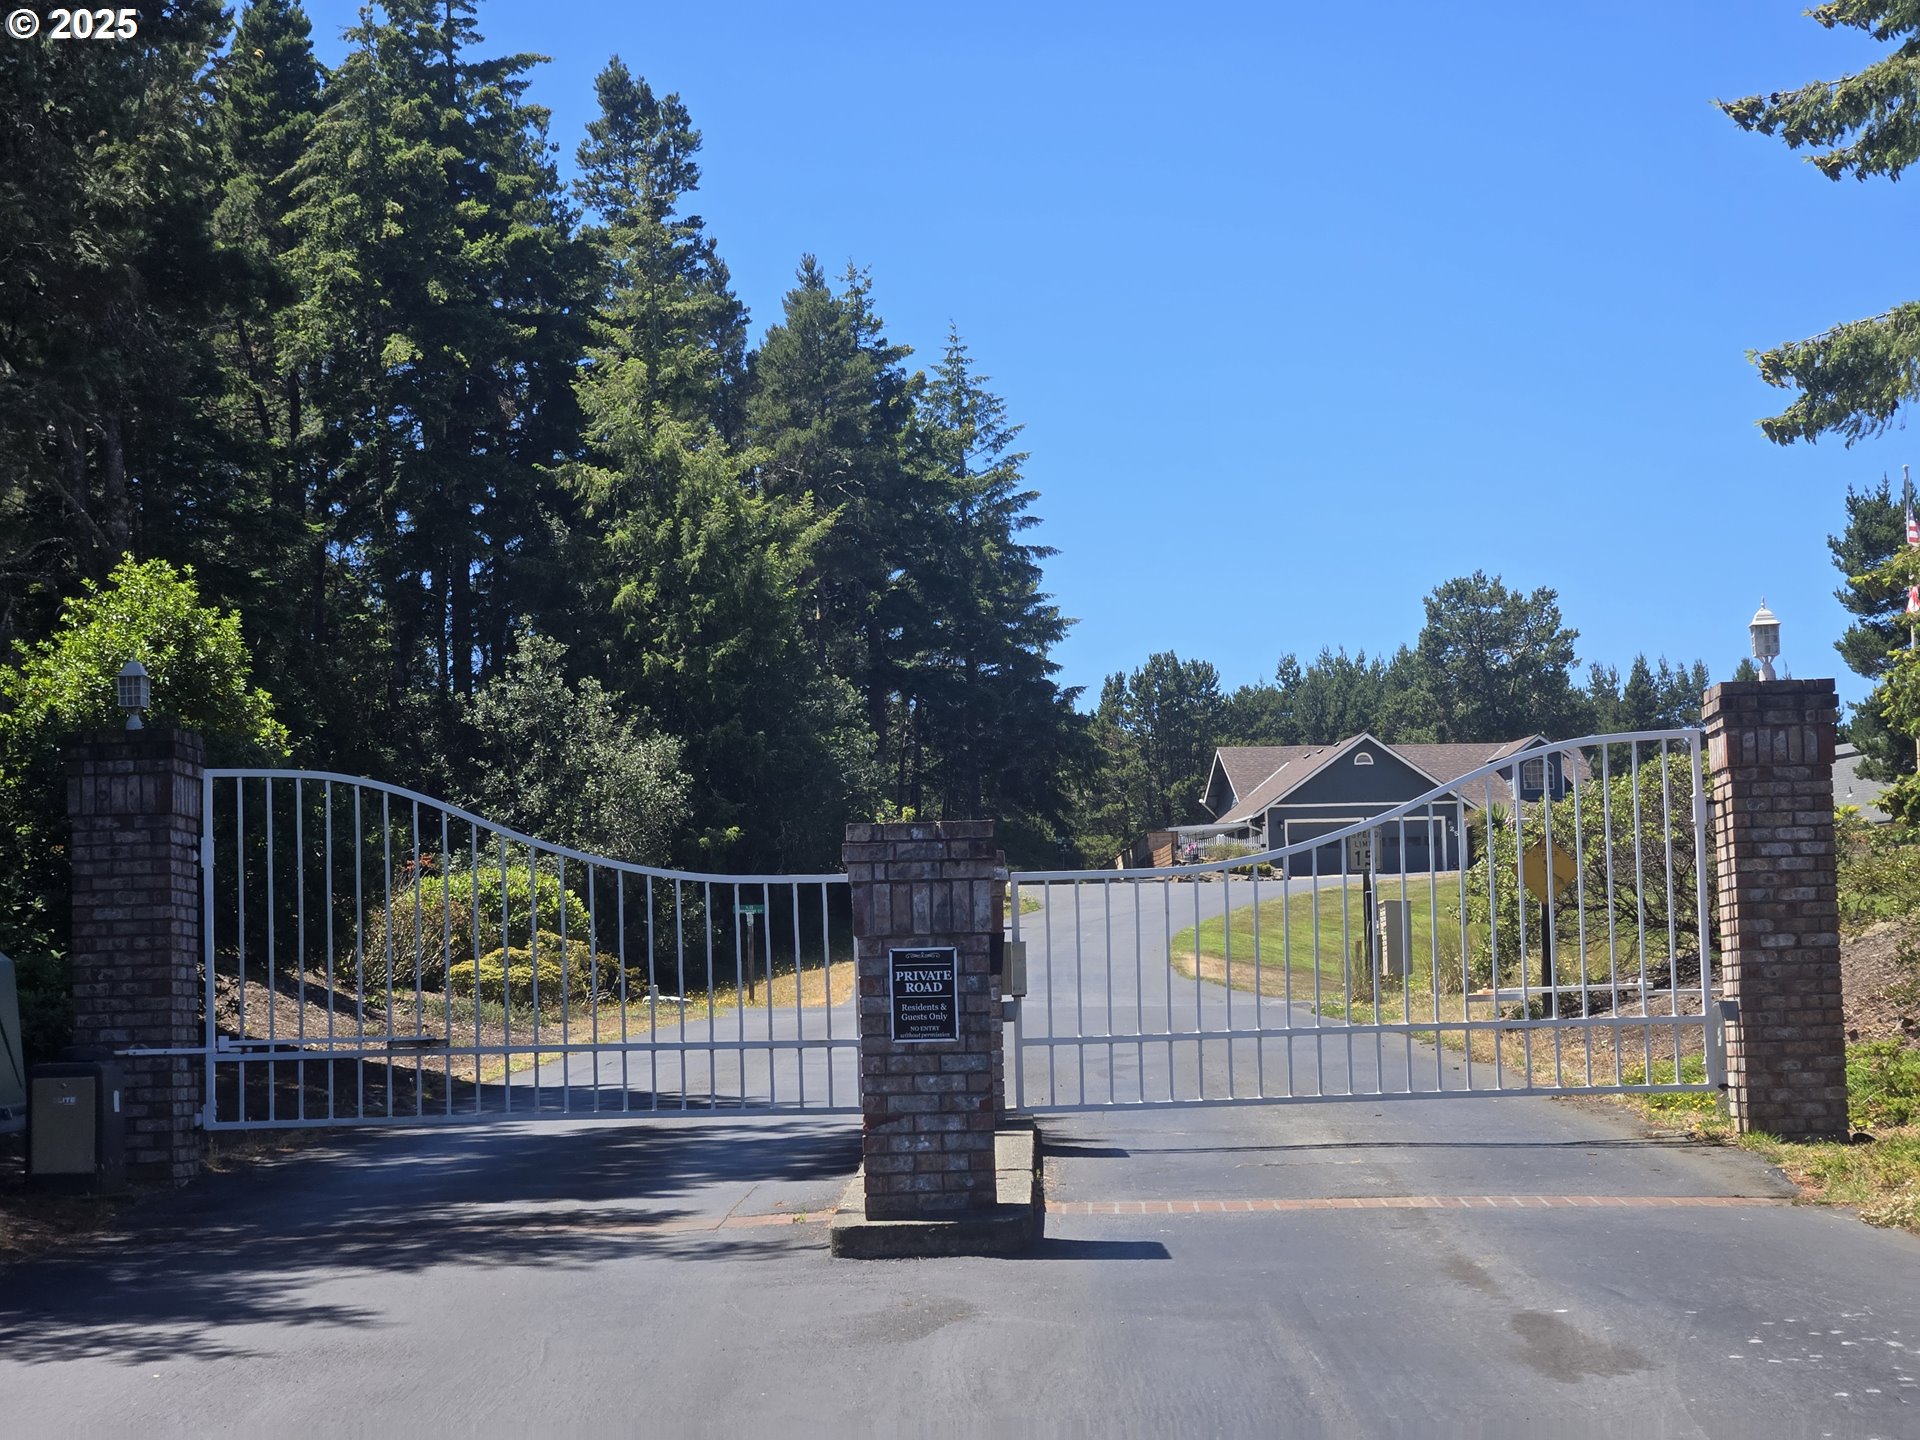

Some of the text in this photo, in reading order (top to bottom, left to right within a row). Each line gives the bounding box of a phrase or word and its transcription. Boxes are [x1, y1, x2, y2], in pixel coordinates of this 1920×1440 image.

[1351, 830, 1379, 839] SPED
[1355, 850, 1371, 867] 15
[895, 970, 952, 981] PRIVATE
[905, 982, 943, 993] ROAD
[901, 1003, 939, 1012] Residents
[901, 1012, 948, 1022] Guests Only
